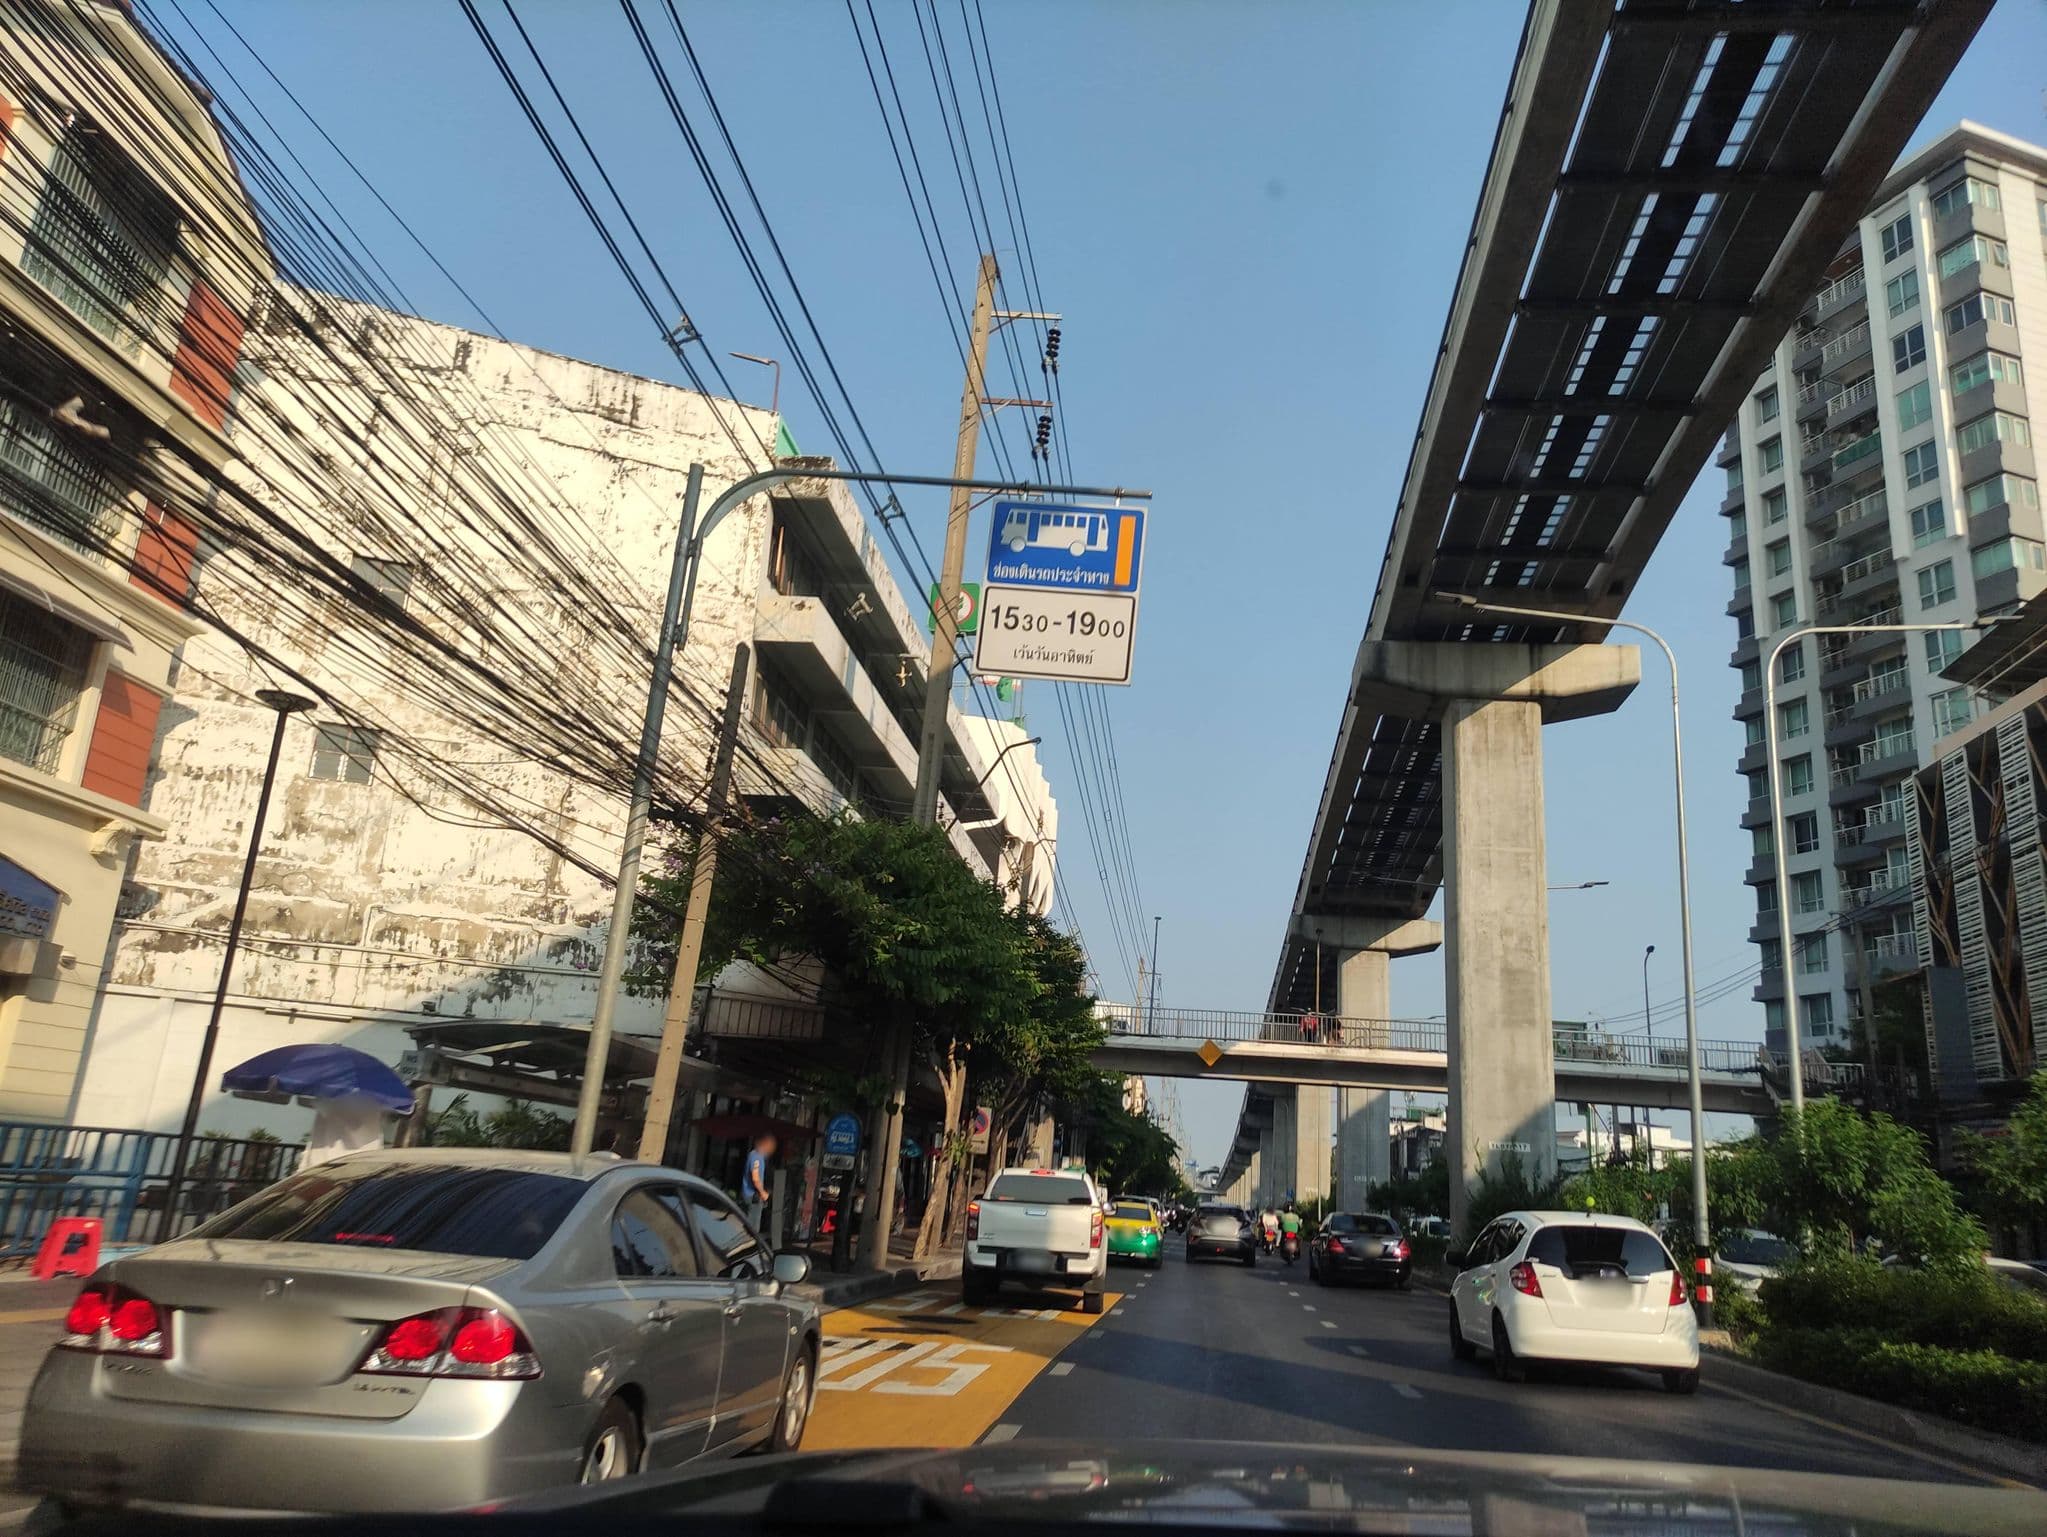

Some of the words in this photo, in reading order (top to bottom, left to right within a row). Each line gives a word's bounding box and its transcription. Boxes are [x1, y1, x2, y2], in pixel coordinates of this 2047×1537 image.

[993, 561, 1110, 585] ช่องเดินรถประจำทาง
[1013, 644, 1096, 665] เว้นวันอาทิตย์
